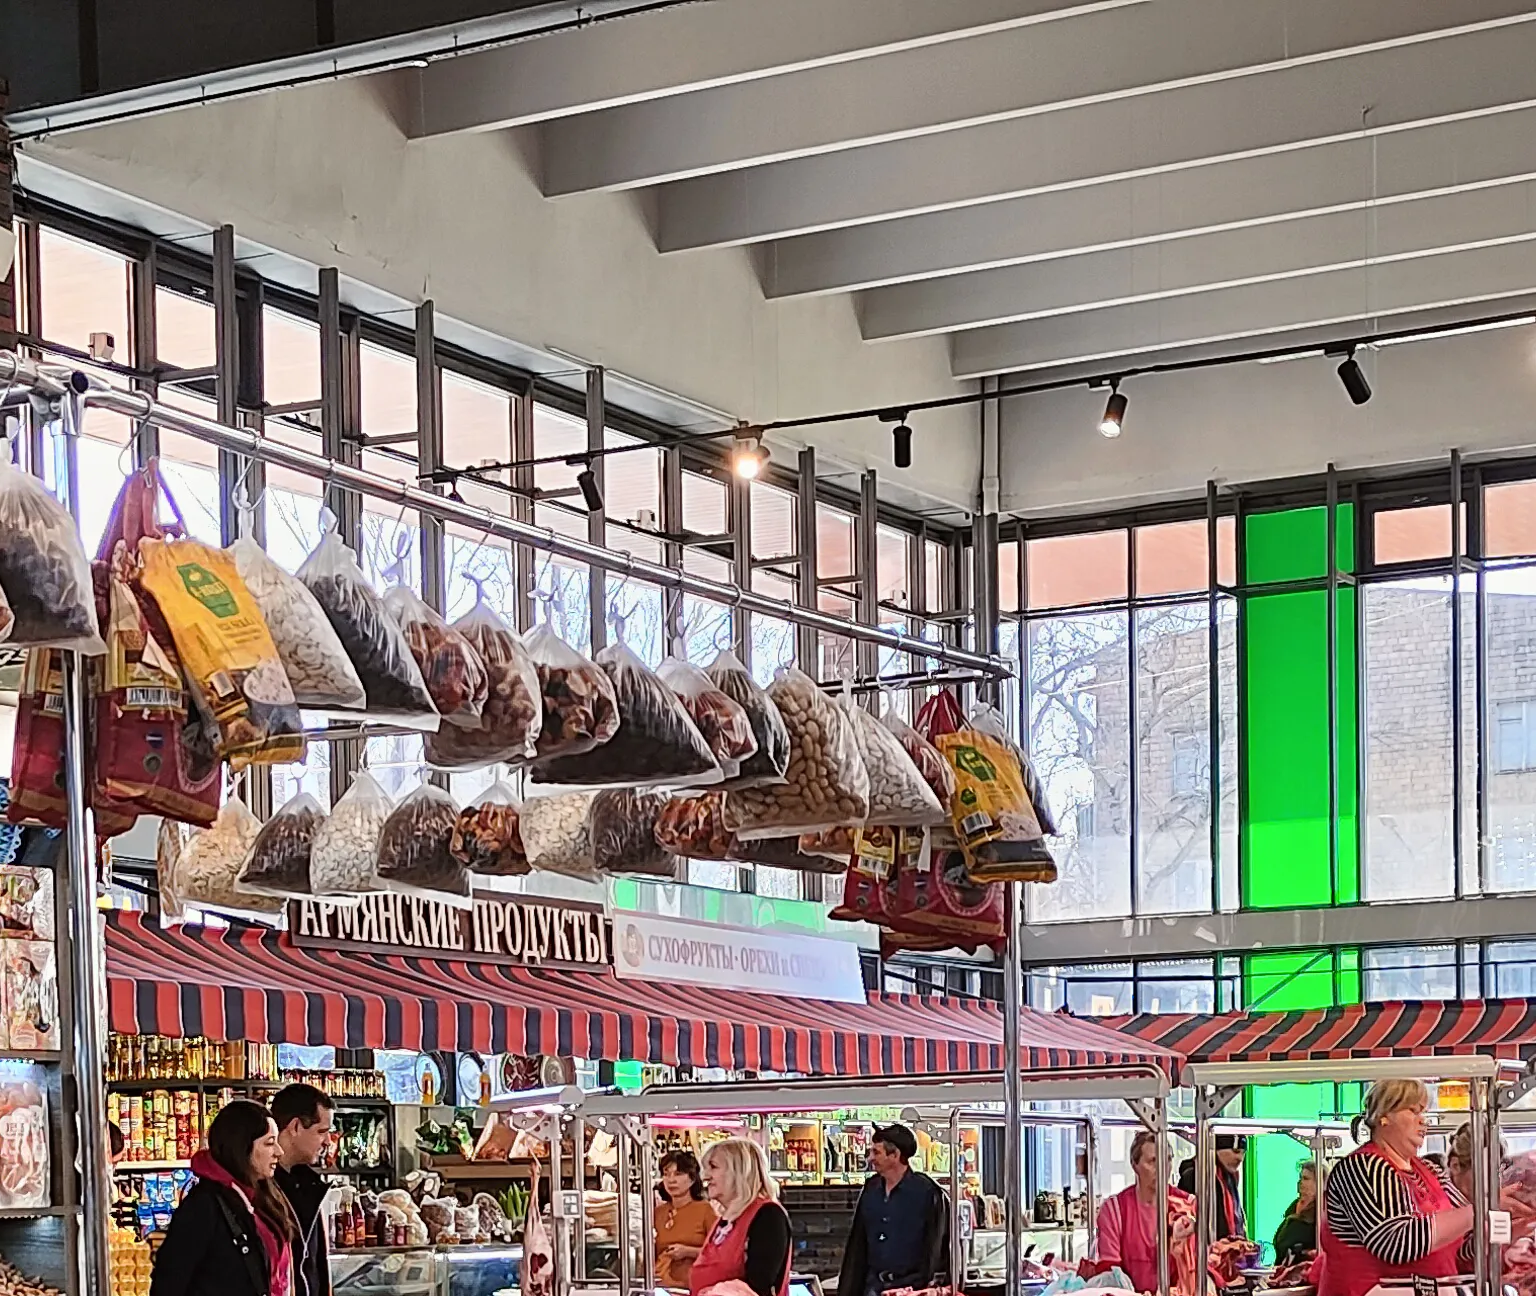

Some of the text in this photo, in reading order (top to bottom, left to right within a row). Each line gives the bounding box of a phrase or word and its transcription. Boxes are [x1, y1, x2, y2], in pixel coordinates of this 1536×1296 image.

[298, 893, 609, 966] АРМЯНСКИЕ ПРОДУКТЫ
[648, 934, 734, 971] СУХОФРУКТЫ
[740, 946, 781, 977] ОРЕХИ
